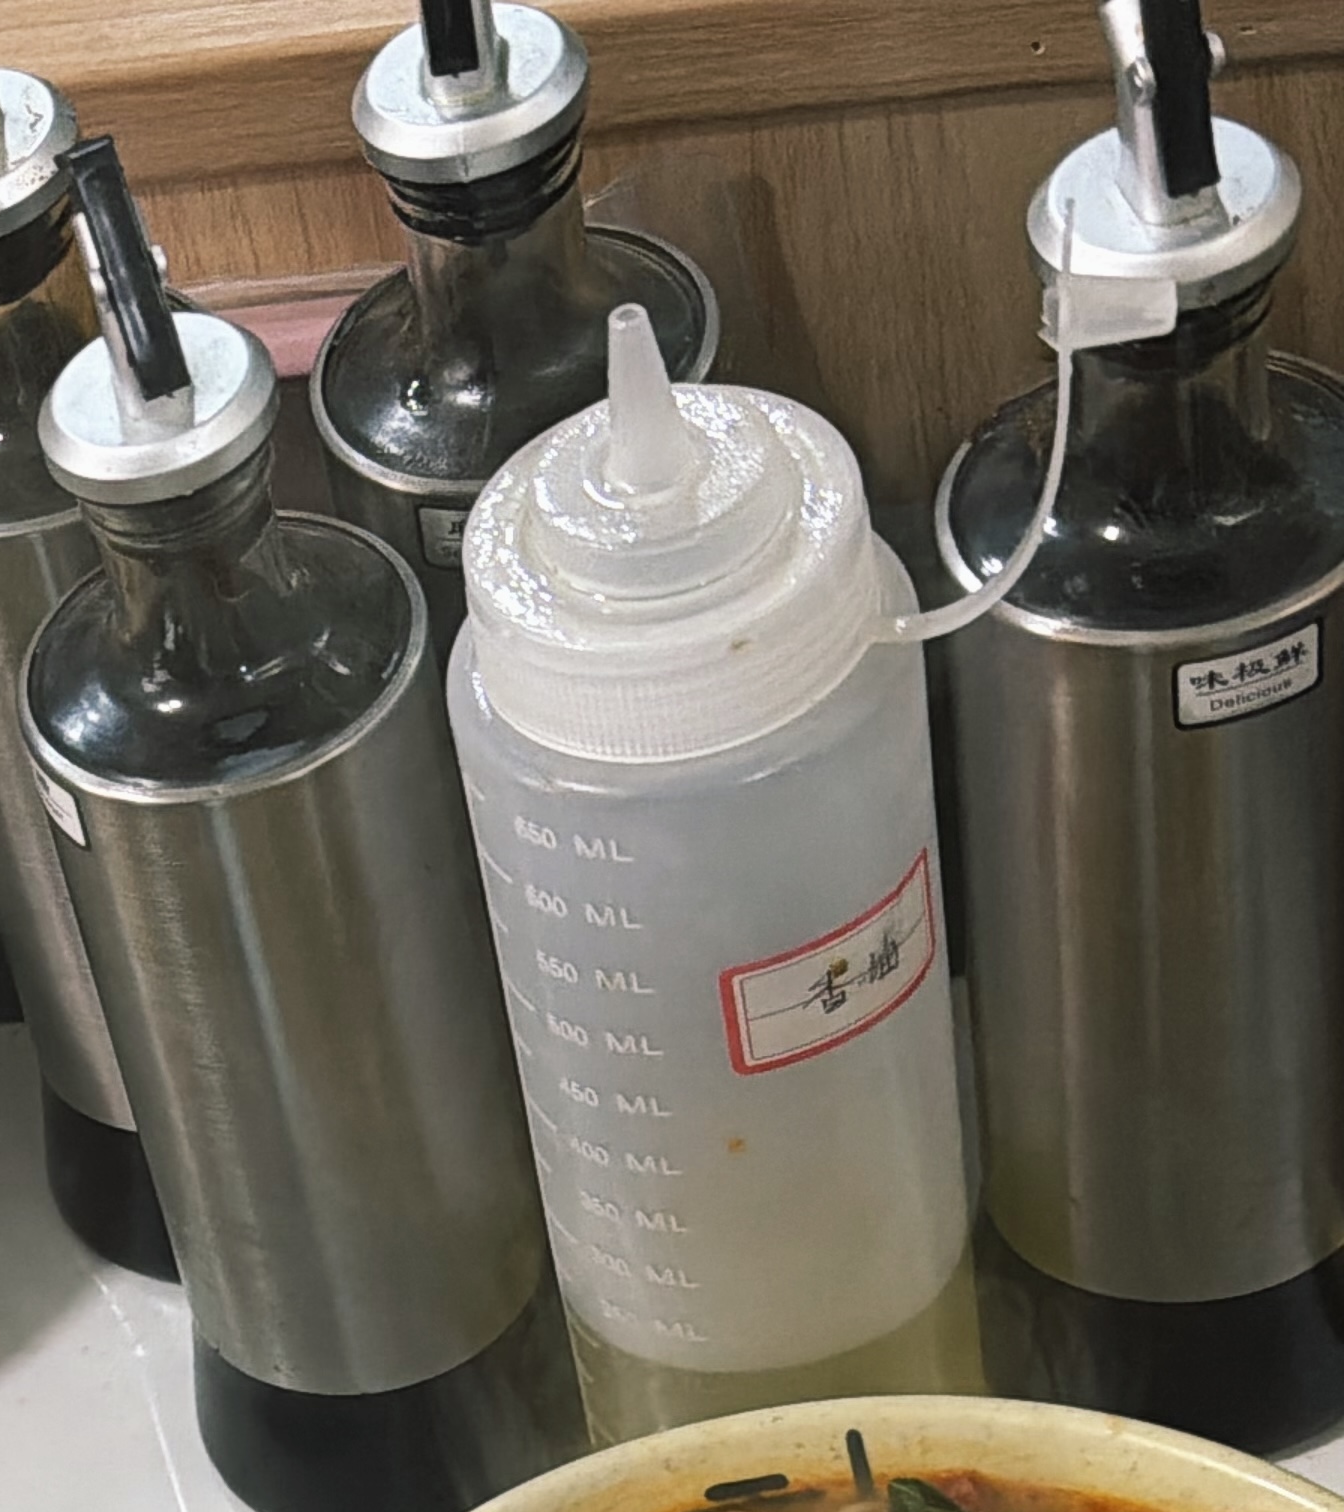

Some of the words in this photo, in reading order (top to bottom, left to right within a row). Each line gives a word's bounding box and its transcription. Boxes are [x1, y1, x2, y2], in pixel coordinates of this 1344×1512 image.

[1188, 641, 1307, 691] 味极鲜
[1209, 677, 1293, 712] Delicious
[574, 834, 634, 862] ML
[585, 903, 642, 929] ML
[536, 950, 578, 983] 550
[595, 969, 654, 994] ML
[546, 1012, 589, 1047] 500
[605, 1032, 664, 1055] ML
[559, 1077, 599, 1107] 450
[616, 1094, 673, 1116] ML
[625, 1153, 683, 1175] ML
[635, 1210, 689, 1232] ML
[645, 1265, 701, 1288] ML
